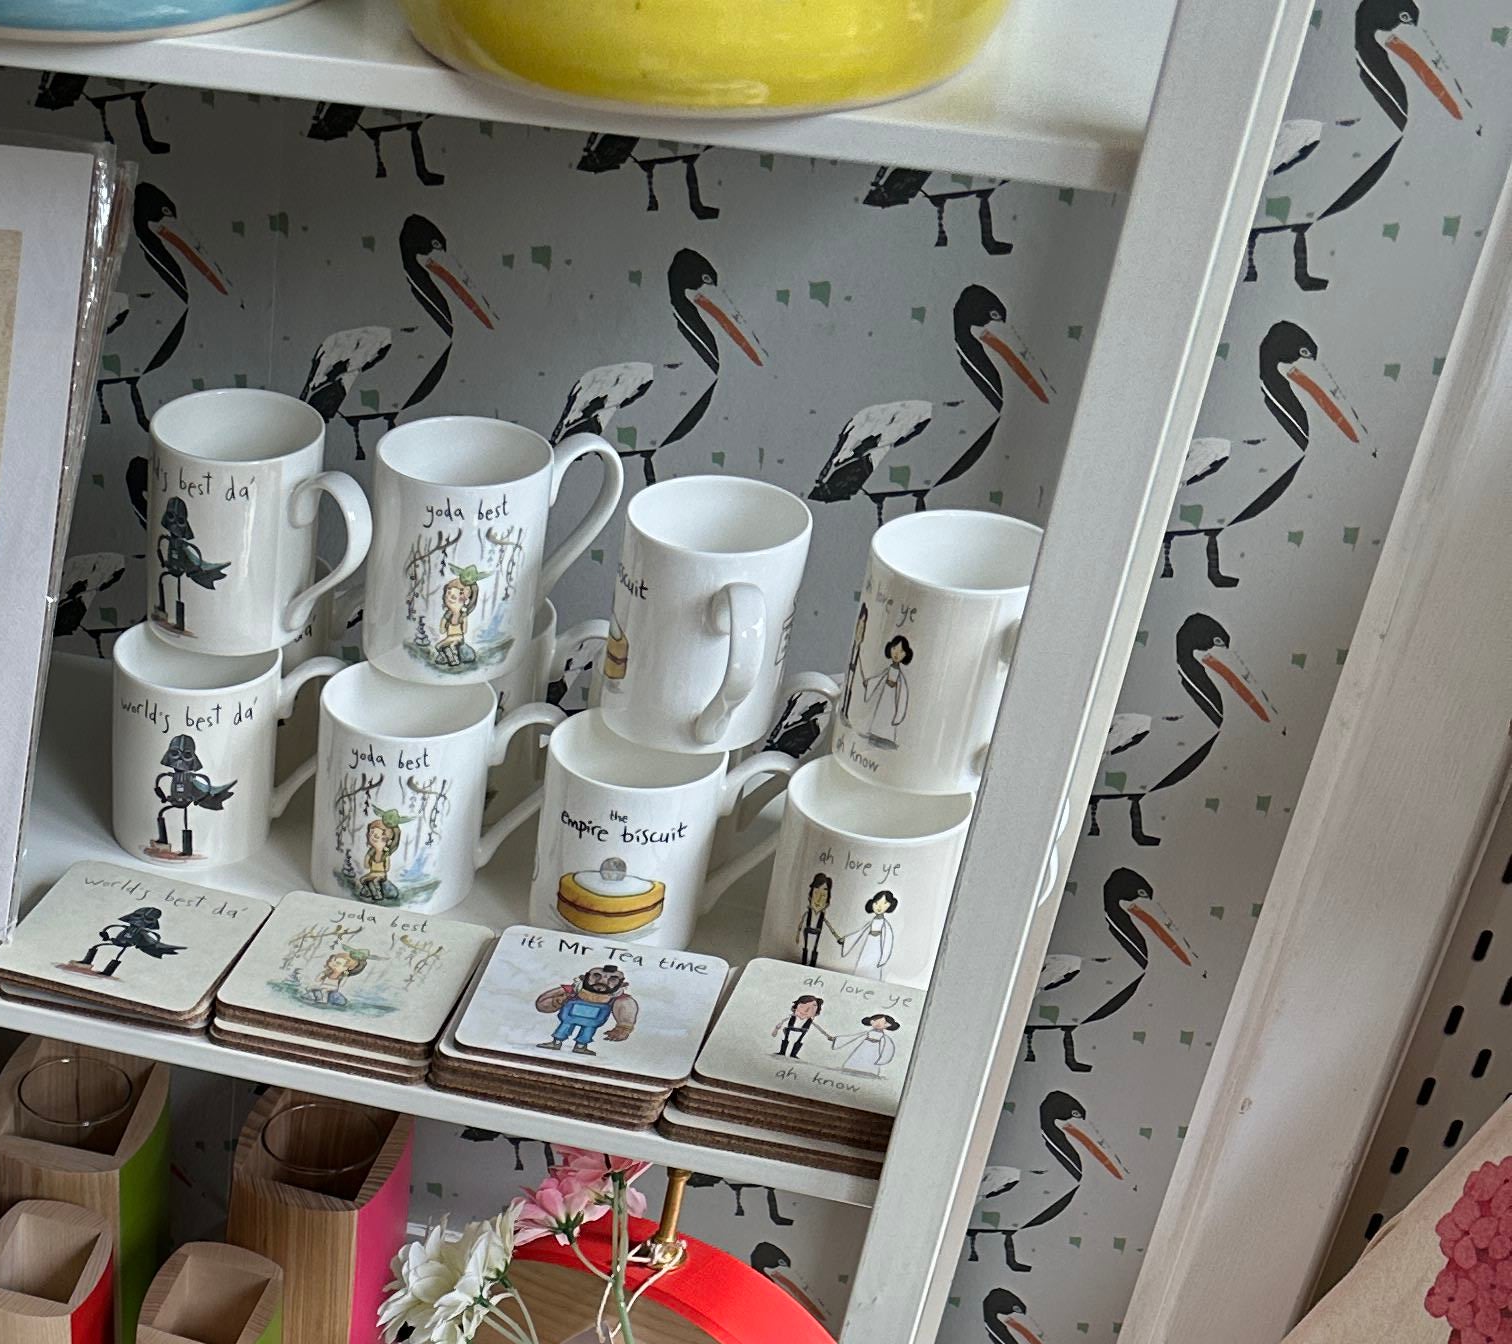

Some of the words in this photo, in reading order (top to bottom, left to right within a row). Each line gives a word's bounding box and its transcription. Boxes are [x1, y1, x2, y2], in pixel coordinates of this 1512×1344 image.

[179, 467, 213, 498] best
[422, 497, 465, 528] yoda
[477, 494, 510, 521] best
[896, 604, 918, 628] ye
[120, 699, 171, 734] world's
[185, 705, 223, 732] best
[349, 743, 386, 770] yoda
[398, 747, 432, 771] best
[850, 741, 880, 773] know
[560, 809, 609, 843] empire
[622, 822, 689, 846] biscuit
[609, 809, 629, 825] the
[819, 847, 835, 866] ah
[845, 850, 873, 876] love
[882, 860, 902, 884] ye
[84, 873, 151, 901] world's
[165, 888, 208, 910] best
[329, 907, 378, 925] yoda
[390, 914, 429, 934] best
[521, 933, 544, 950] it's
[558, 938, 595, 957] Mr
[603, 945, 644, 967] Tea
[659, 957, 710, 976] time
[803, 974, 825, 988] ah
[839, 980, 875, 1000] love
[881, 994, 913, 1010] ye
[774, 1066, 798, 1081] ah
[812, 1071, 862, 1094] know
